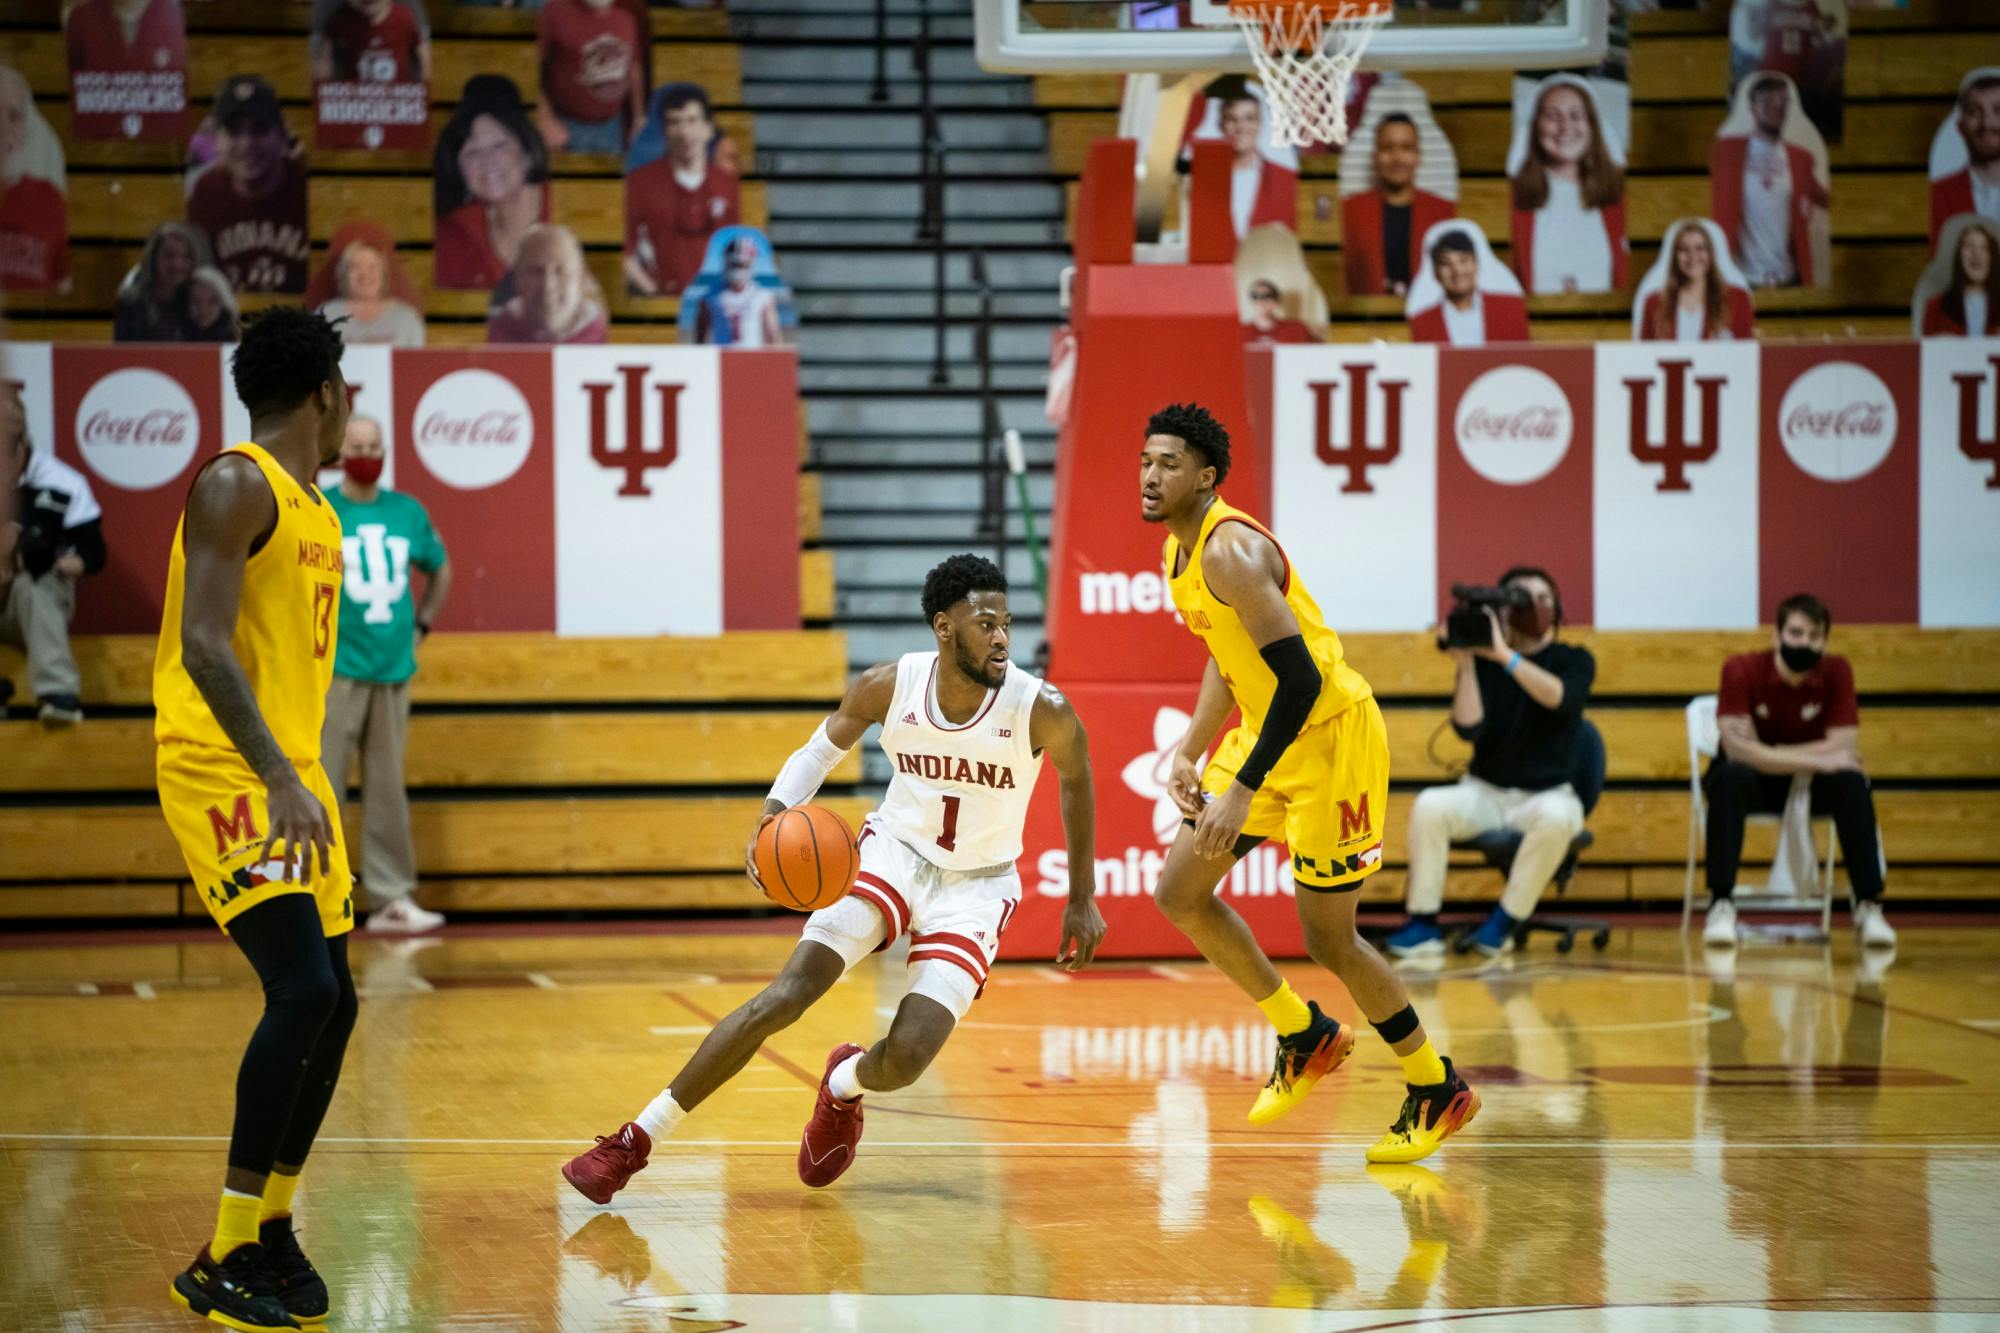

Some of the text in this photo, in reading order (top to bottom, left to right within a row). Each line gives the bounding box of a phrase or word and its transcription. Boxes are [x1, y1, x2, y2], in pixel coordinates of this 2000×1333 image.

[313, 581, 335, 661] 13
[896, 752, 1016, 790] INDIANA
[205, 792, 263, 858] M
[936, 795, 961, 852] 1
[1336, 790, 1372, 841] M
